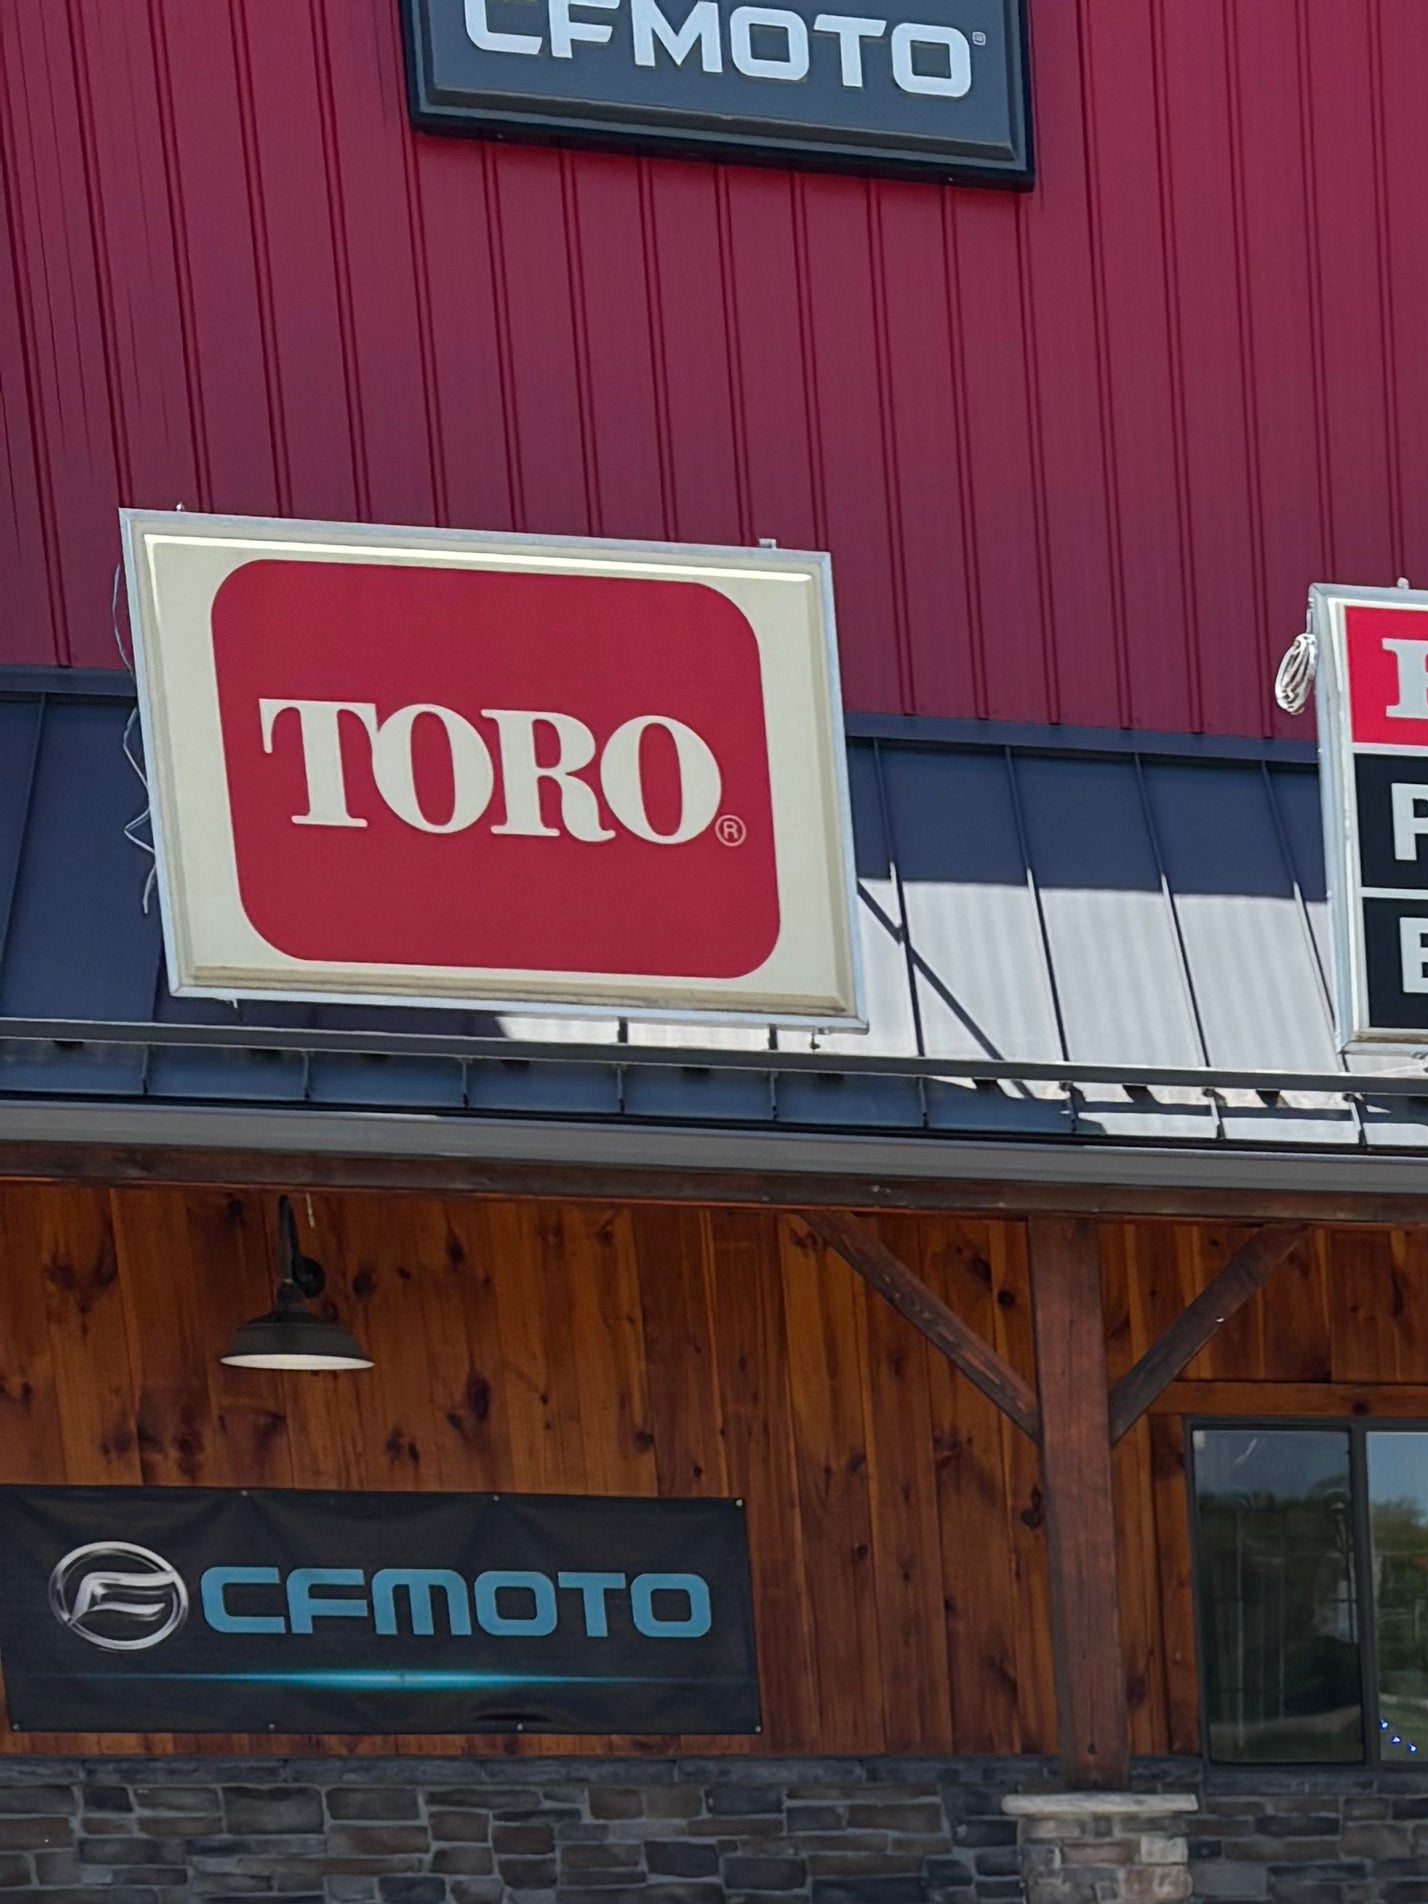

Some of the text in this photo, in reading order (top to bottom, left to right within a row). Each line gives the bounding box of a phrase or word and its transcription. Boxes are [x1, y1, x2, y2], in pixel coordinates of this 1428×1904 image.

[465, 0, 971, 97] CFMOTO
[259, 697, 723, 845] TORO
[200, 1566, 713, 1639] CFMOTO
